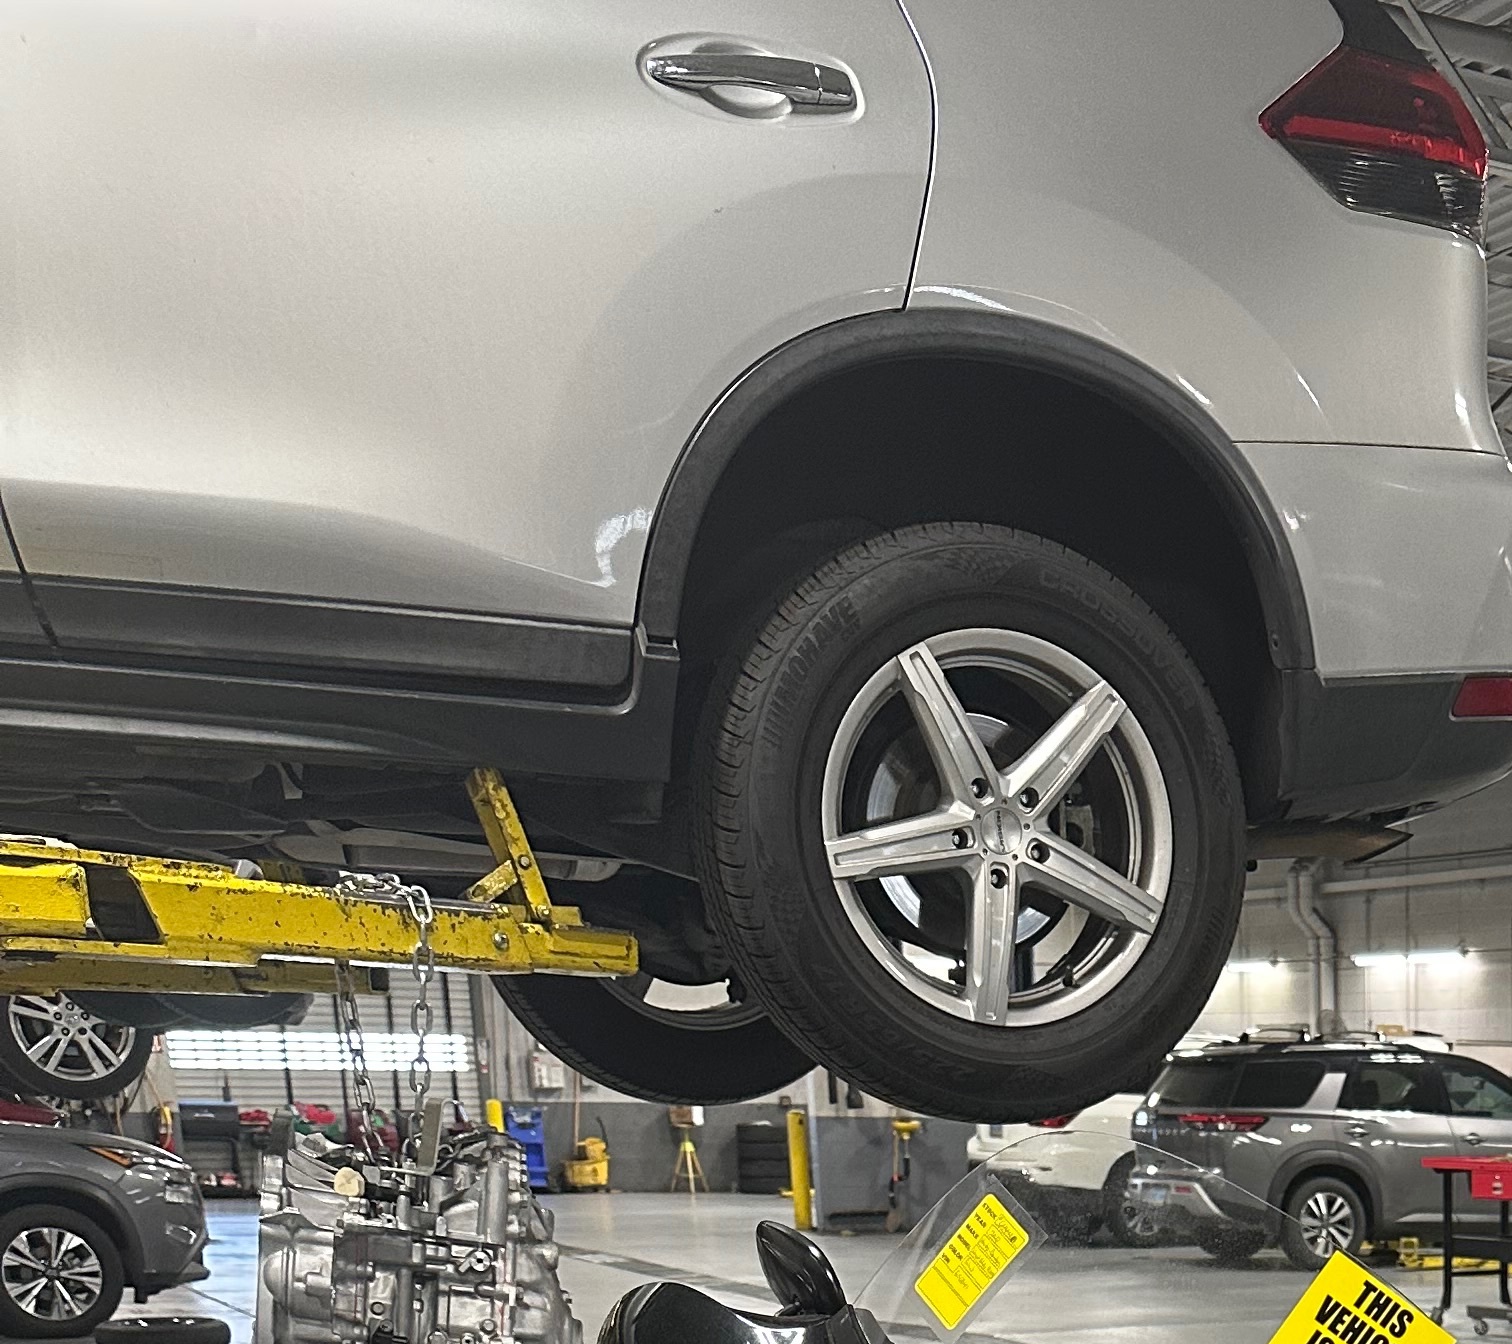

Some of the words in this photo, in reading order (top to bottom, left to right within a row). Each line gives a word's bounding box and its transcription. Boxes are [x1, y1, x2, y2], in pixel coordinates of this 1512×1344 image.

[1040, 570, 1198, 710] CROSSOVER
[974, 1212, 988, 1229] YEAR
[1352, 1279, 1414, 1338] THIS
